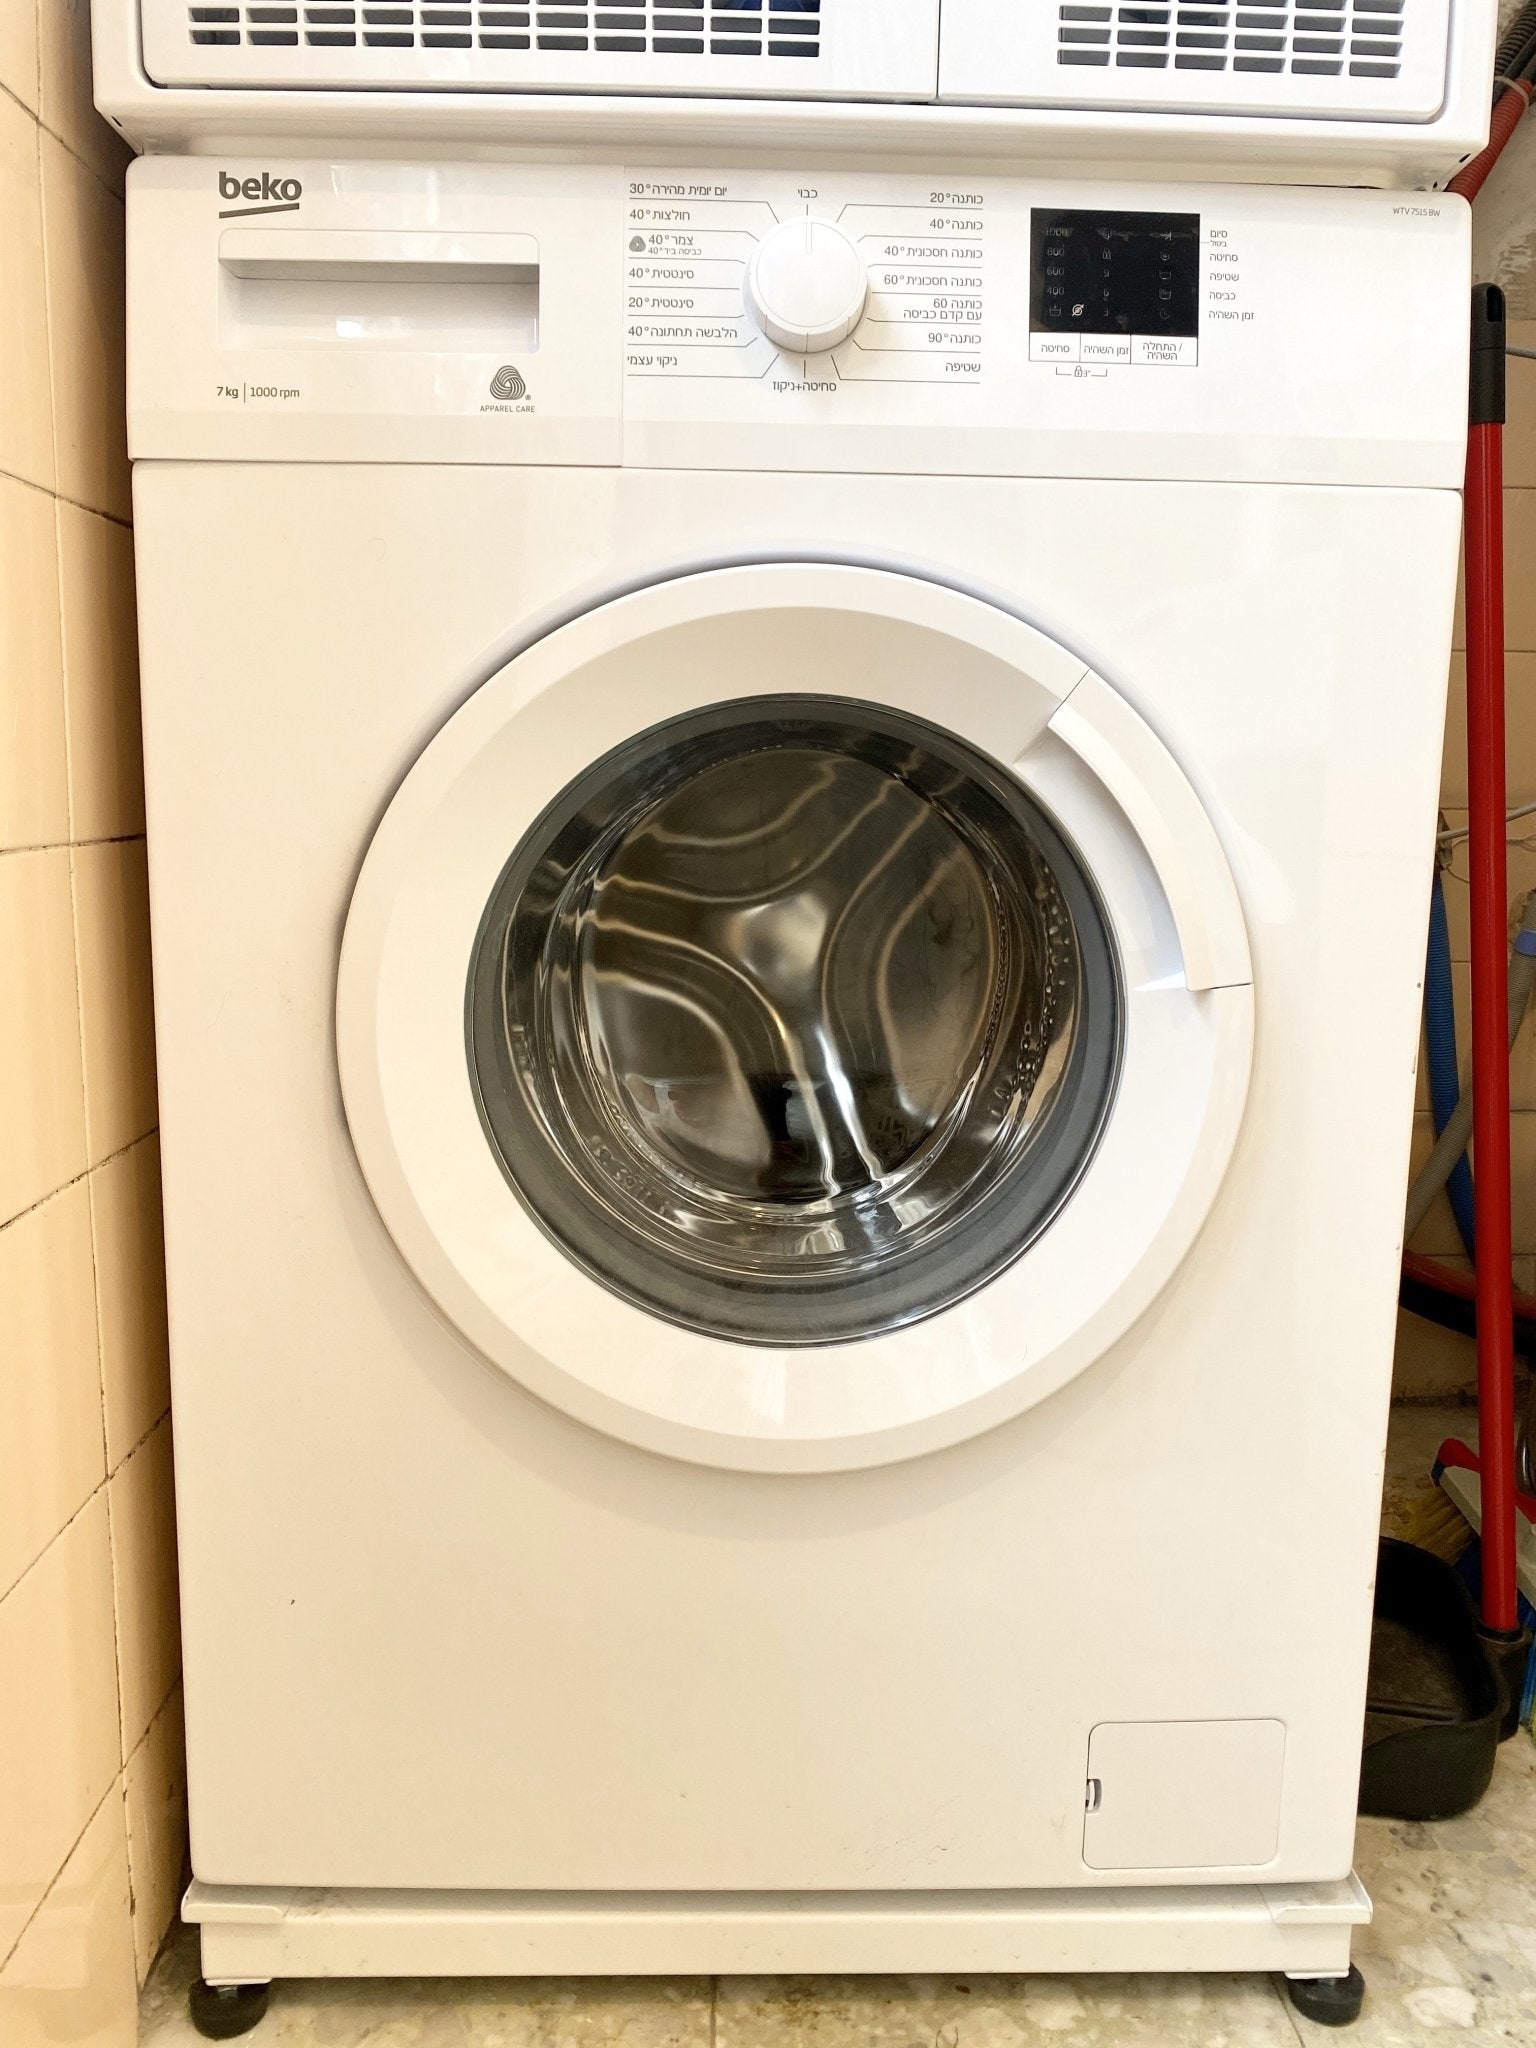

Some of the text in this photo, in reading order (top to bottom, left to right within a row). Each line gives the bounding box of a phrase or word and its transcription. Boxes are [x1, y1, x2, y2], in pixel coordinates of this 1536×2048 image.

[219, 172, 302, 200] beko
[652, 186, 685, 195] מהירה
[688, 187, 711, 195] יומית
[714, 187, 727, 196] יום
[798, 189, 817, 198] כבוי
[952, 195, 983, 204] כותנה
[652, 210, 690, 220] חולצות
[952, 220, 983, 230] כותנה
[1210, 230, 1228, 238] סיום
[671, 236, 693, 245] צמר
[907, 248, 947, 257] חסכונית
[951, 250, 983, 258] כותנה
[1209, 254, 1238, 262] סחיטה
[651, 269, 694, 279] סינטטית
[1209, 273, 1239, 281] שטיפה
[906, 276, 947, 286] חסכונית
[951, 278, 982, 287] כותנה
[1209, 292, 1236, 300] כביסה
[651, 299, 694, 308] סינטטית
[934, 299, 982, 309] כותנה 60
[904, 310, 937, 319] כביסה
[940, 311, 963, 322] קדם
[1209, 310, 1254, 321] זמן השהיה
[651, 328, 693, 337] תחתונה
[696, 329, 737, 338] הלבשה
[950, 334, 981, 344] כותנה
[1041, 344, 1070, 353] סחיטה
[1084, 345, 1129, 356] זמן השהיה
[627, 355, 678, 366] ניקוי עצמי
[1147, 351, 1178, 361] השהיה
[945, 363, 981, 372] שטיפה
[217, 386, 300, 399] 7 kg 1000 rpm
[480, 404, 535, 413] APPAREL CARE
